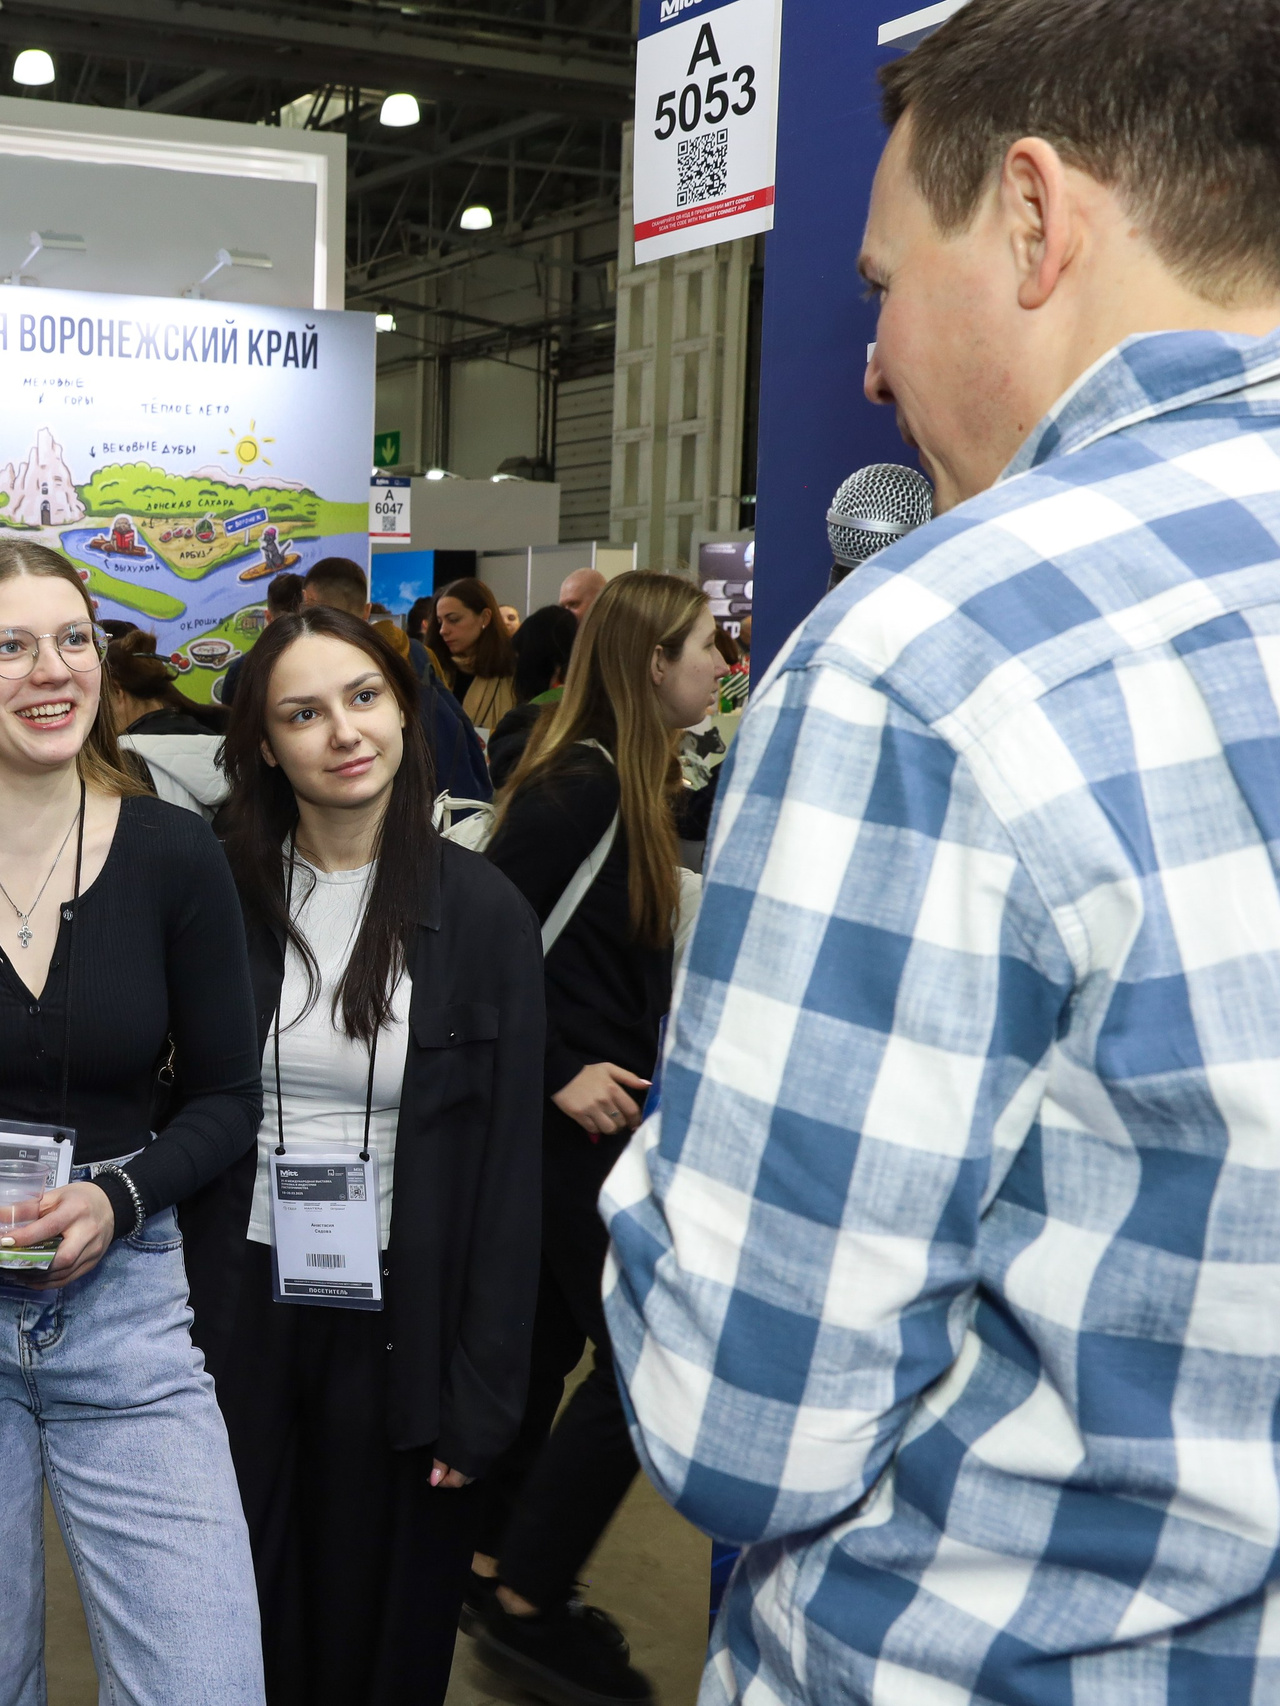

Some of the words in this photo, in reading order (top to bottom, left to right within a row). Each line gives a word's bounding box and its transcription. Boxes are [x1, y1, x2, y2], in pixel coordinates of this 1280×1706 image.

[686, 22, 721, 77] A
[654, 64, 757, 141] 5053
[735, 194, 755, 205] CONNECT
[658, 223, 669, 232] SCAN
[676, 219, 687, 227] CODE
[706, 211, 718, 219] MITT
[717, 206, 737, 216] CONNECT
[19, 313, 238, 364] ВОРОНЕЖСКИЙ
[248, 323, 319, 370] КРАЙ
[64, 396, 94, 406] ГОРЫ
[198, 404, 230, 416] ЛЕТО
[102, 441, 158, 454] ВЕКОВЫЕ
[161, 443, 196, 455] ДУБЫ
[384, 489, 394, 501] A
[145, 500, 192, 511] ДОНСКАЯ
[197, 498, 235, 507] САХАРА
[375, 502, 403, 515] 6047
[179, 549, 206, 560] АРБУЗ
[114, 563, 160, 573] ВЫХУХОЛЬ
[180, 617, 224, 631] ОКРОШКА
[280, 1169, 299, 1177] Mitt
[308, 1287, 349, 1296] ПОСЕТИТЕЛЬ
